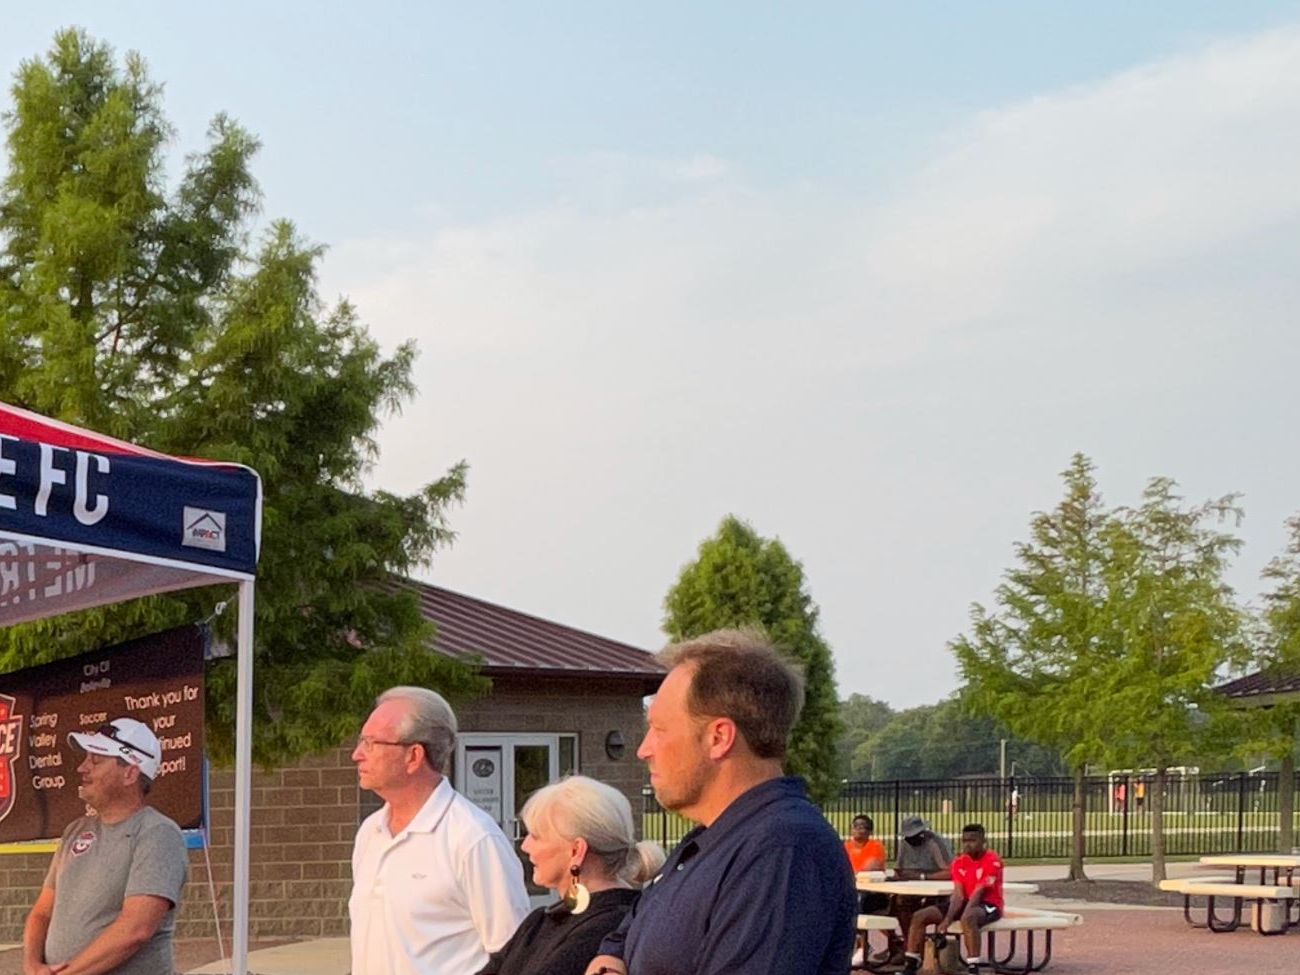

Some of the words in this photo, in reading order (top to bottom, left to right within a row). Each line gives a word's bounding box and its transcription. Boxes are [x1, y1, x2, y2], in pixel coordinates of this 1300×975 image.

[35, 441, 110, 526] FC
[124, 691, 160, 711] Thank
[161, 690, 182, 708] you
[183, 685, 199, 701] for
[29, 712, 58, 728] Spring
[79, 711, 107, 725] Soccer
[152, 714, 176, 732] your
[29, 733, 57, 748] Valley
[29, 752, 62, 769] Dental
[32, 775, 65, 789] Group
